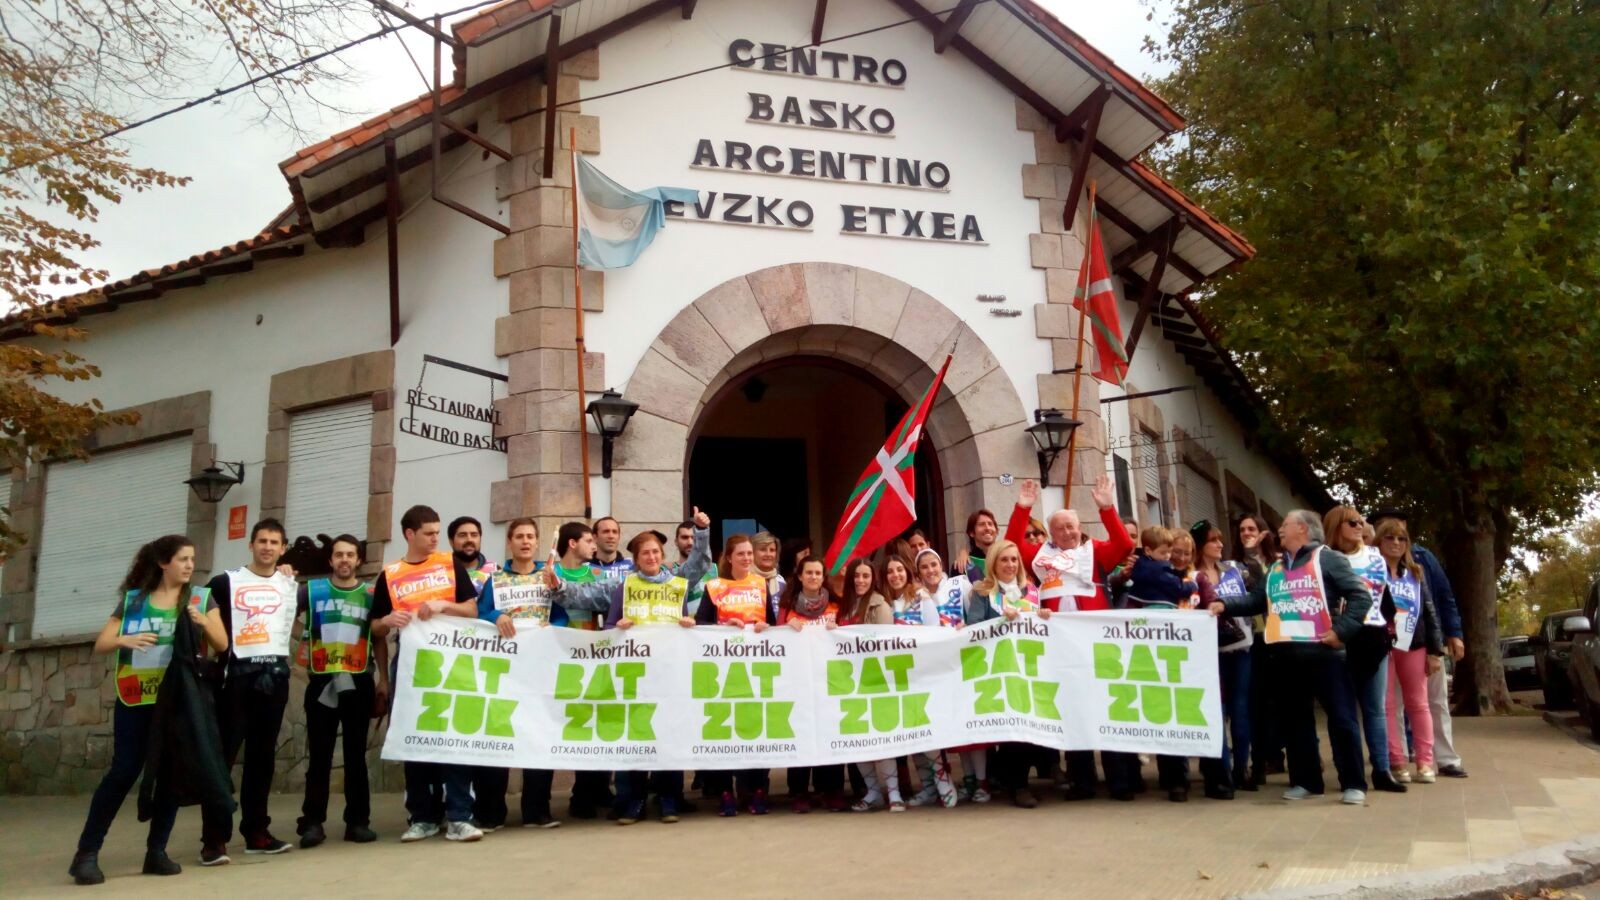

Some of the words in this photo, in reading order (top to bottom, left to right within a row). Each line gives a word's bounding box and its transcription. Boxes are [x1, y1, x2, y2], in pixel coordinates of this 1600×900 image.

[728, 38, 907, 86] CENTRO
[747, 92, 895, 134] BASKO
[691, 138, 950, 188] ARGENTINO
[840, 204, 984, 241] ETXEA
[406, 389, 502, 425] RESTAURANT
[400, 417, 459, 445] CENTRO
[464, 433, 508, 453] BASKO
[393, 571, 450, 598] korrika
[510, 587, 551, 600] korrika
[628, 587, 680, 603] korrika
[429, 633, 449, 647] 20.
[452, 630, 518, 654] korrika
[702, 644, 721, 657] 20.
[724, 639, 786, 657] korrika
[836, 642, 855, 656] 20.
[856, 637, 917, 653] korrika
[968, 631, 988, 643] 20.
[989, 617, 1049, 638] korrika
[1102, 626, 1123, 639] 20.
[1125, 621, 1193, 641] korrika
[570, 647, 589, 659] 20.
[590, 639, 651, 659] korrika
[960, 639, 1045, 682] BAT
[1093, 643, 1189, 683] BAT
[412, 649, 511, 694] BAT
[554, 662, 646, 700] BAT
[691, 662, 781, 698] BAT
[827, 654, 914, 696] BAT
[416, 692, 519, 737] ZUK
[839, 693, 931, 735] ZUK
[974, 676, 1062, 720] ZUK
[1108, 683, 1208, 726] ZUK
[562, 703, 657, 742] ZUK
[702, 701, 796, 740] ZUK
[966, 717, 1027, 729] OTXANDIOTIK
[1099, 726, 1164, 738] OTXANDIOTIK
[404, 735, 470, 748] OTXANDIOTIK
[551, 745, 614, 755] OTXANDIOTIK
[692, 745, 754, 754] OTXANDIOTIK
[830, 737, 892, 749] OTXANDIOTIK
